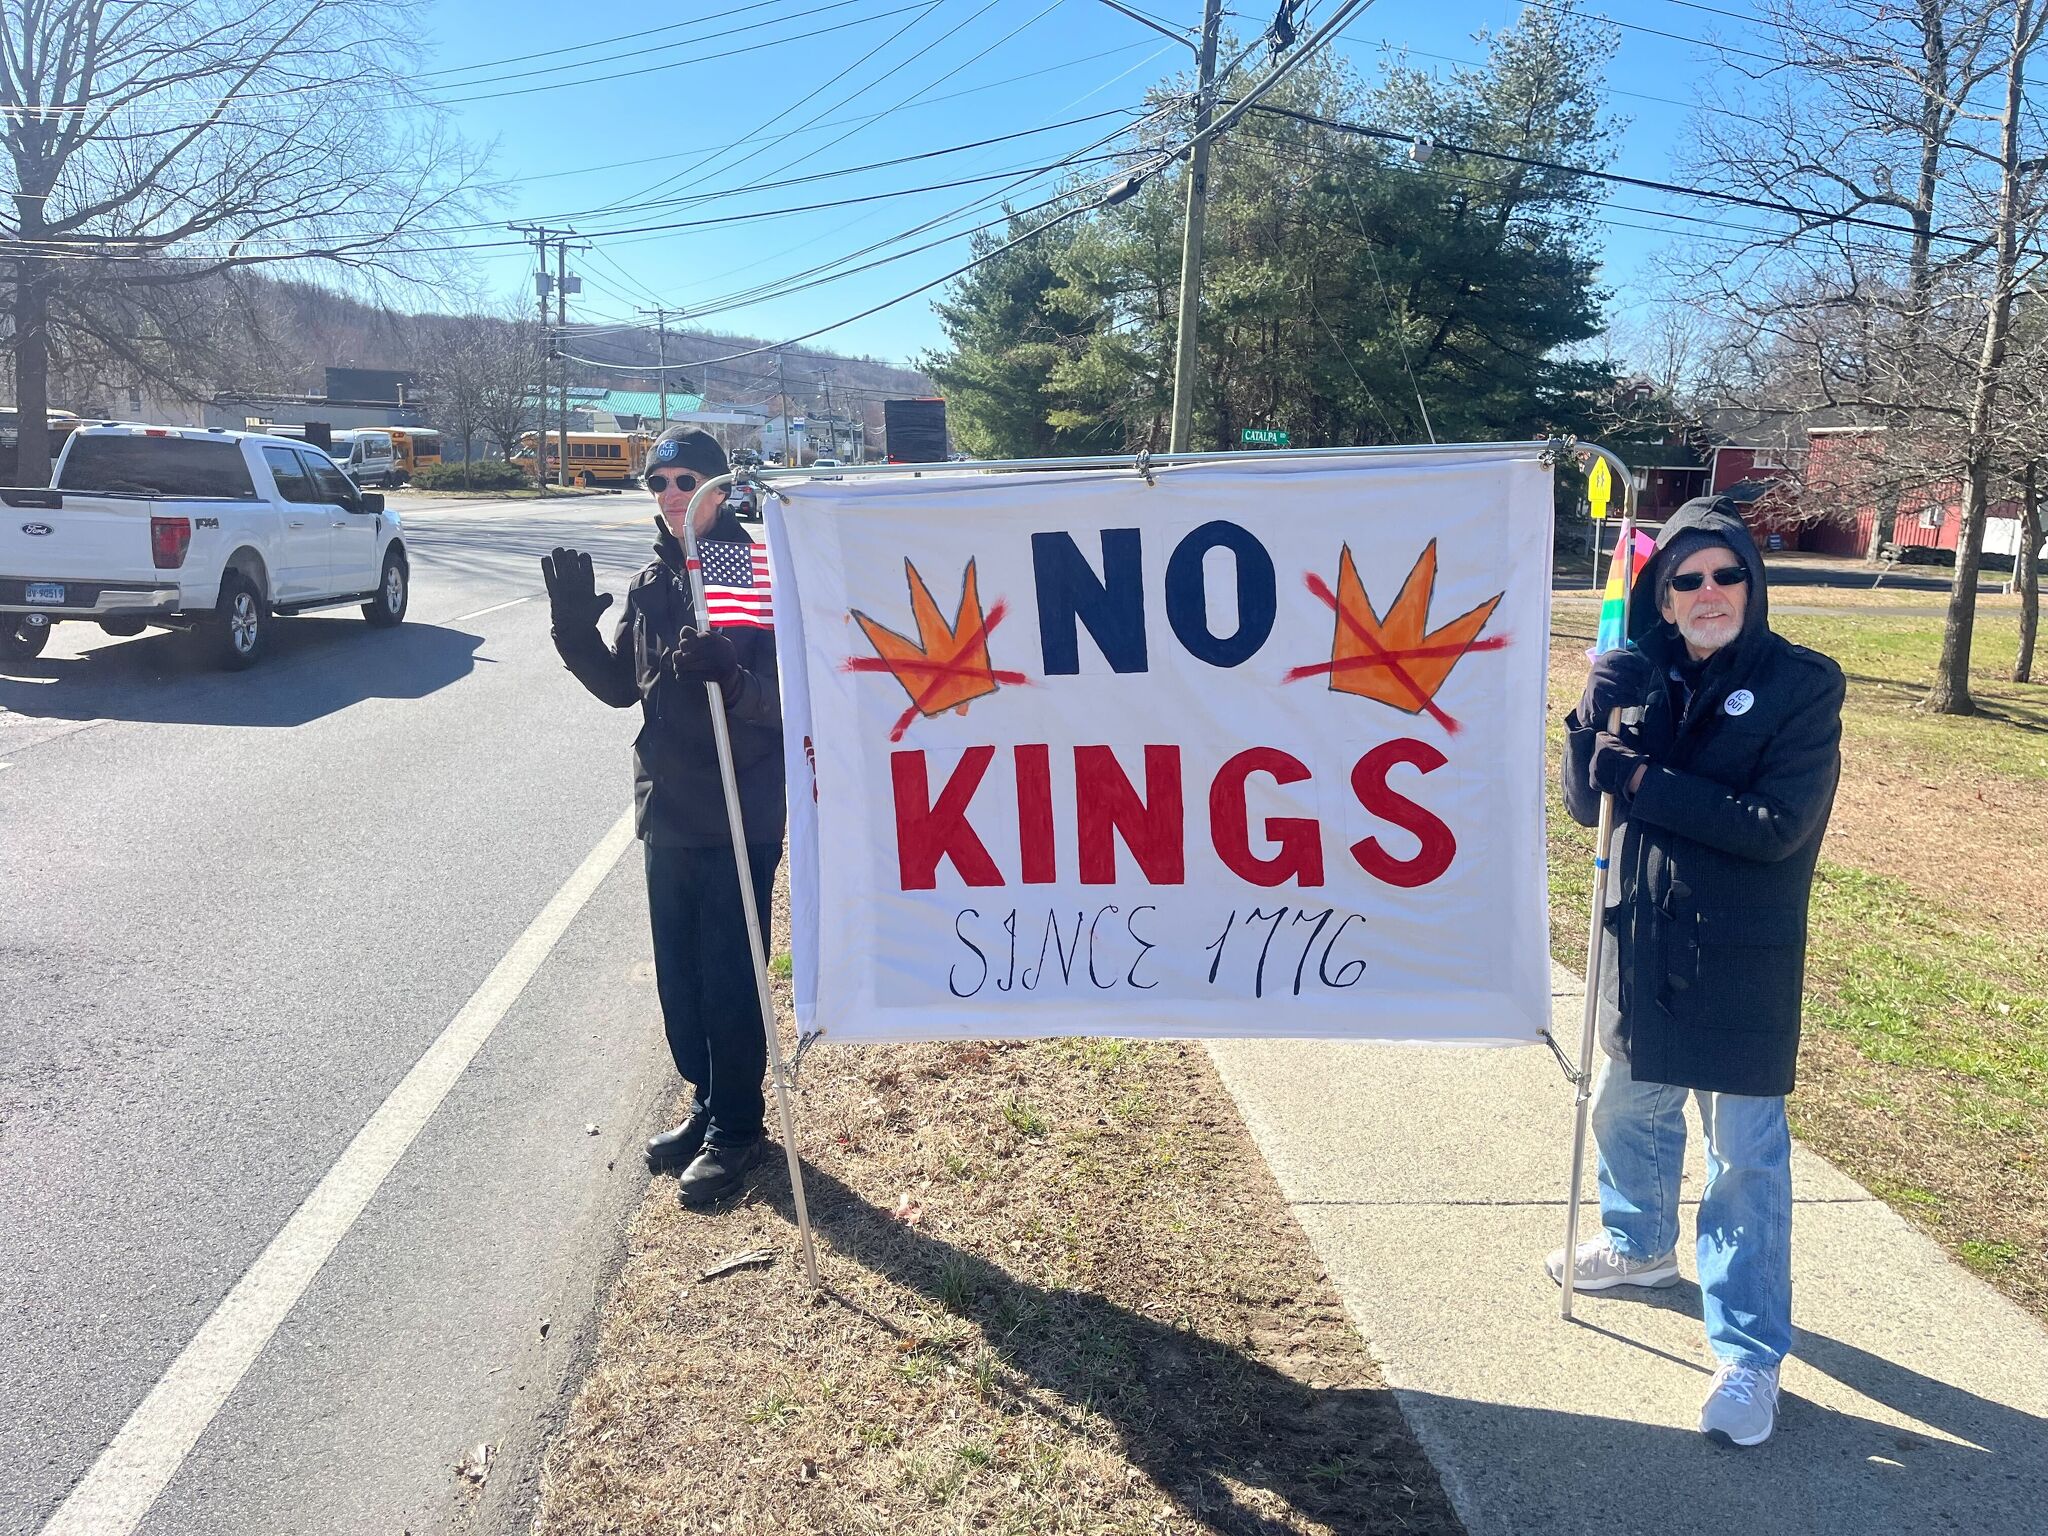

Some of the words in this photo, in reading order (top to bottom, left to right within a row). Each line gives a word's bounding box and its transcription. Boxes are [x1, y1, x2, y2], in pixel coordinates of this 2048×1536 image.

[1245, 430, 1278, 442] CATALPA
[662, 441, 675, 449] ICE
[659, 449, 675, 457] OUT
[26, 525, 48, 535] Ford
[1031, 520, 1277, 675] NO
[1735, 691, 1751, 703] ICE
[1727, 698, 1745, 712] OUT
[891, 738, 1456, 890] KINGS
[950, 905, 1159, 997] SINCE
[1206, 907, 1366, 998] 1776
